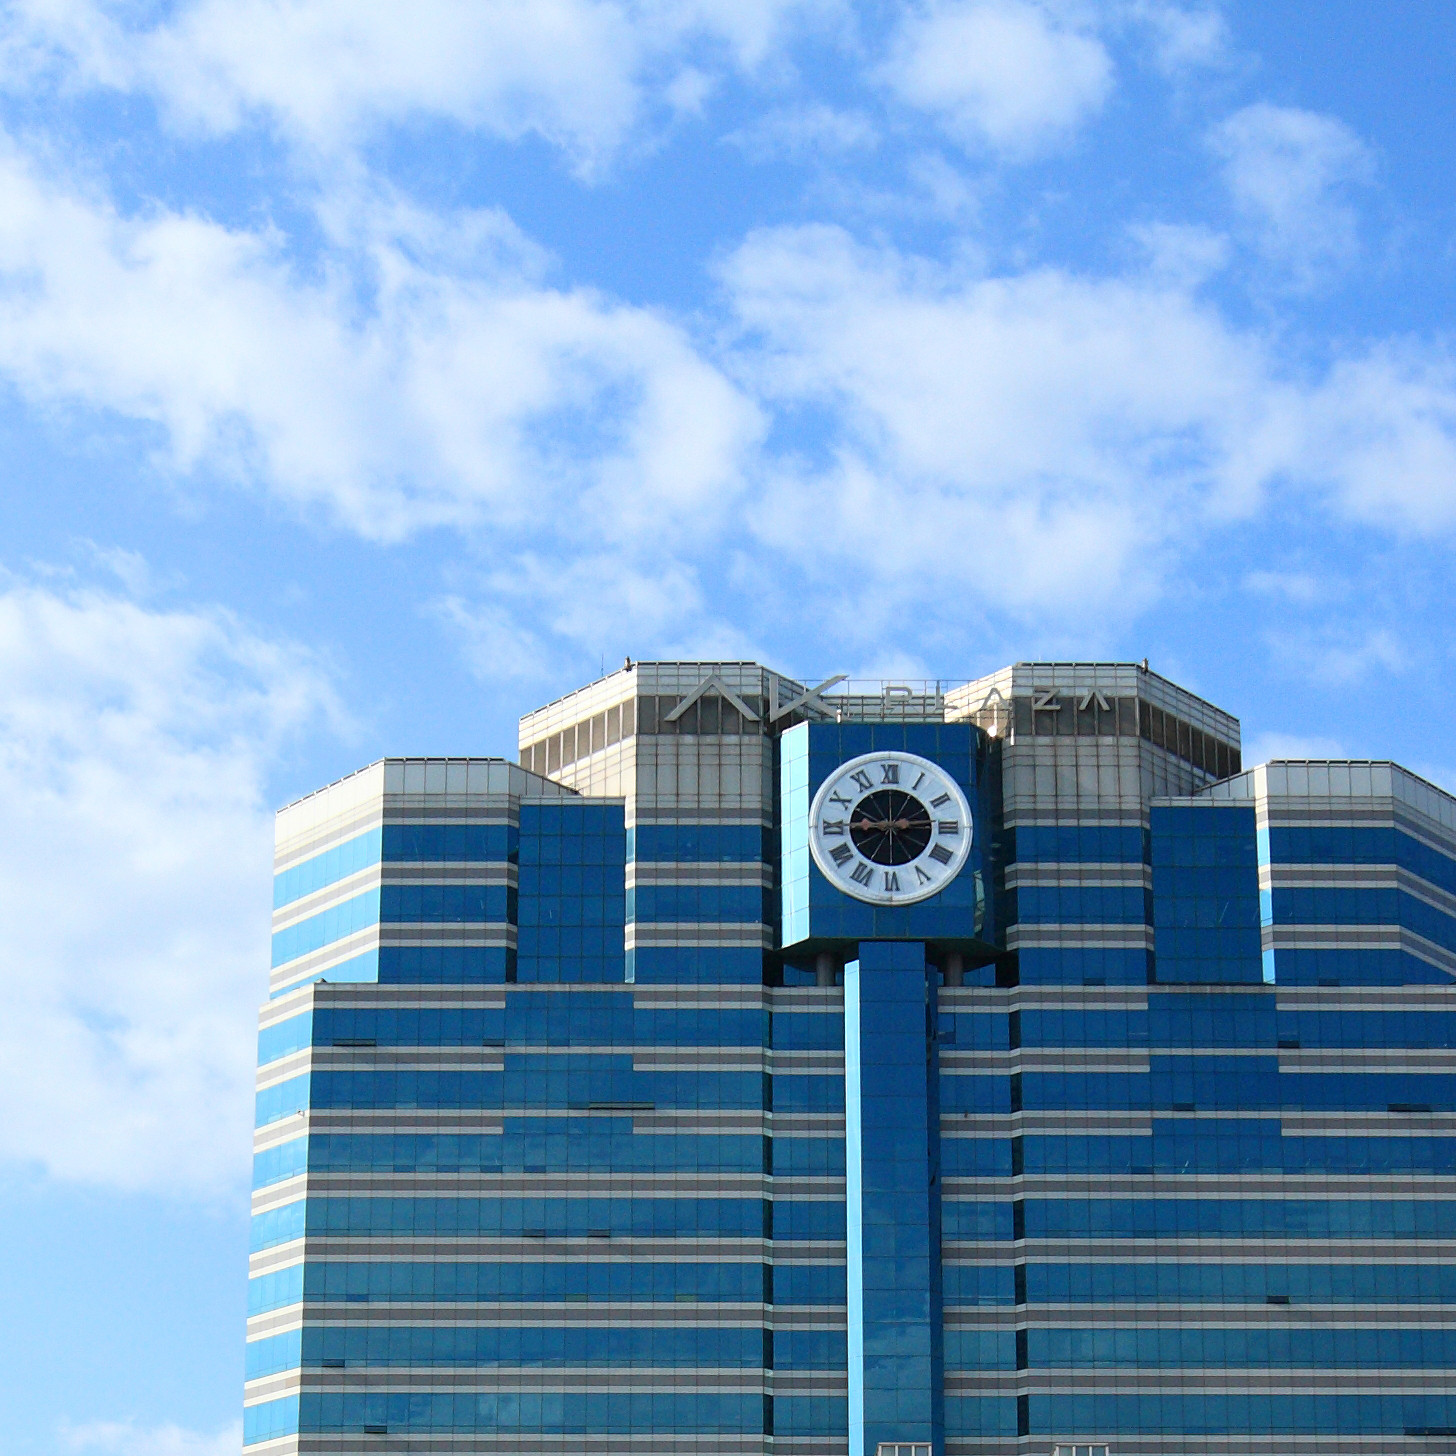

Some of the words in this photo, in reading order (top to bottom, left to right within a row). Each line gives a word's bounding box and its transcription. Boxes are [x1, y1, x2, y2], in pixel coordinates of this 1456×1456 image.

[663, 672, 850, 724] AK
[882, 679, 1112, 713] PLAZA
[849, 768, 874, 794] XI
[880, 763, 900, 785] XII
[911, 771, 926, 791] I
[828, 790, 853, 811] X
[929, 792, 951, 809] II
[822, 818, 844, 836] IX
[937, 819, 959, 835] III
[828, 842, 854, 868] VIII
[849, 861, 875, 887] VII
[884, 870, 901, 892] VI
[914, 865, 931, 886] V
